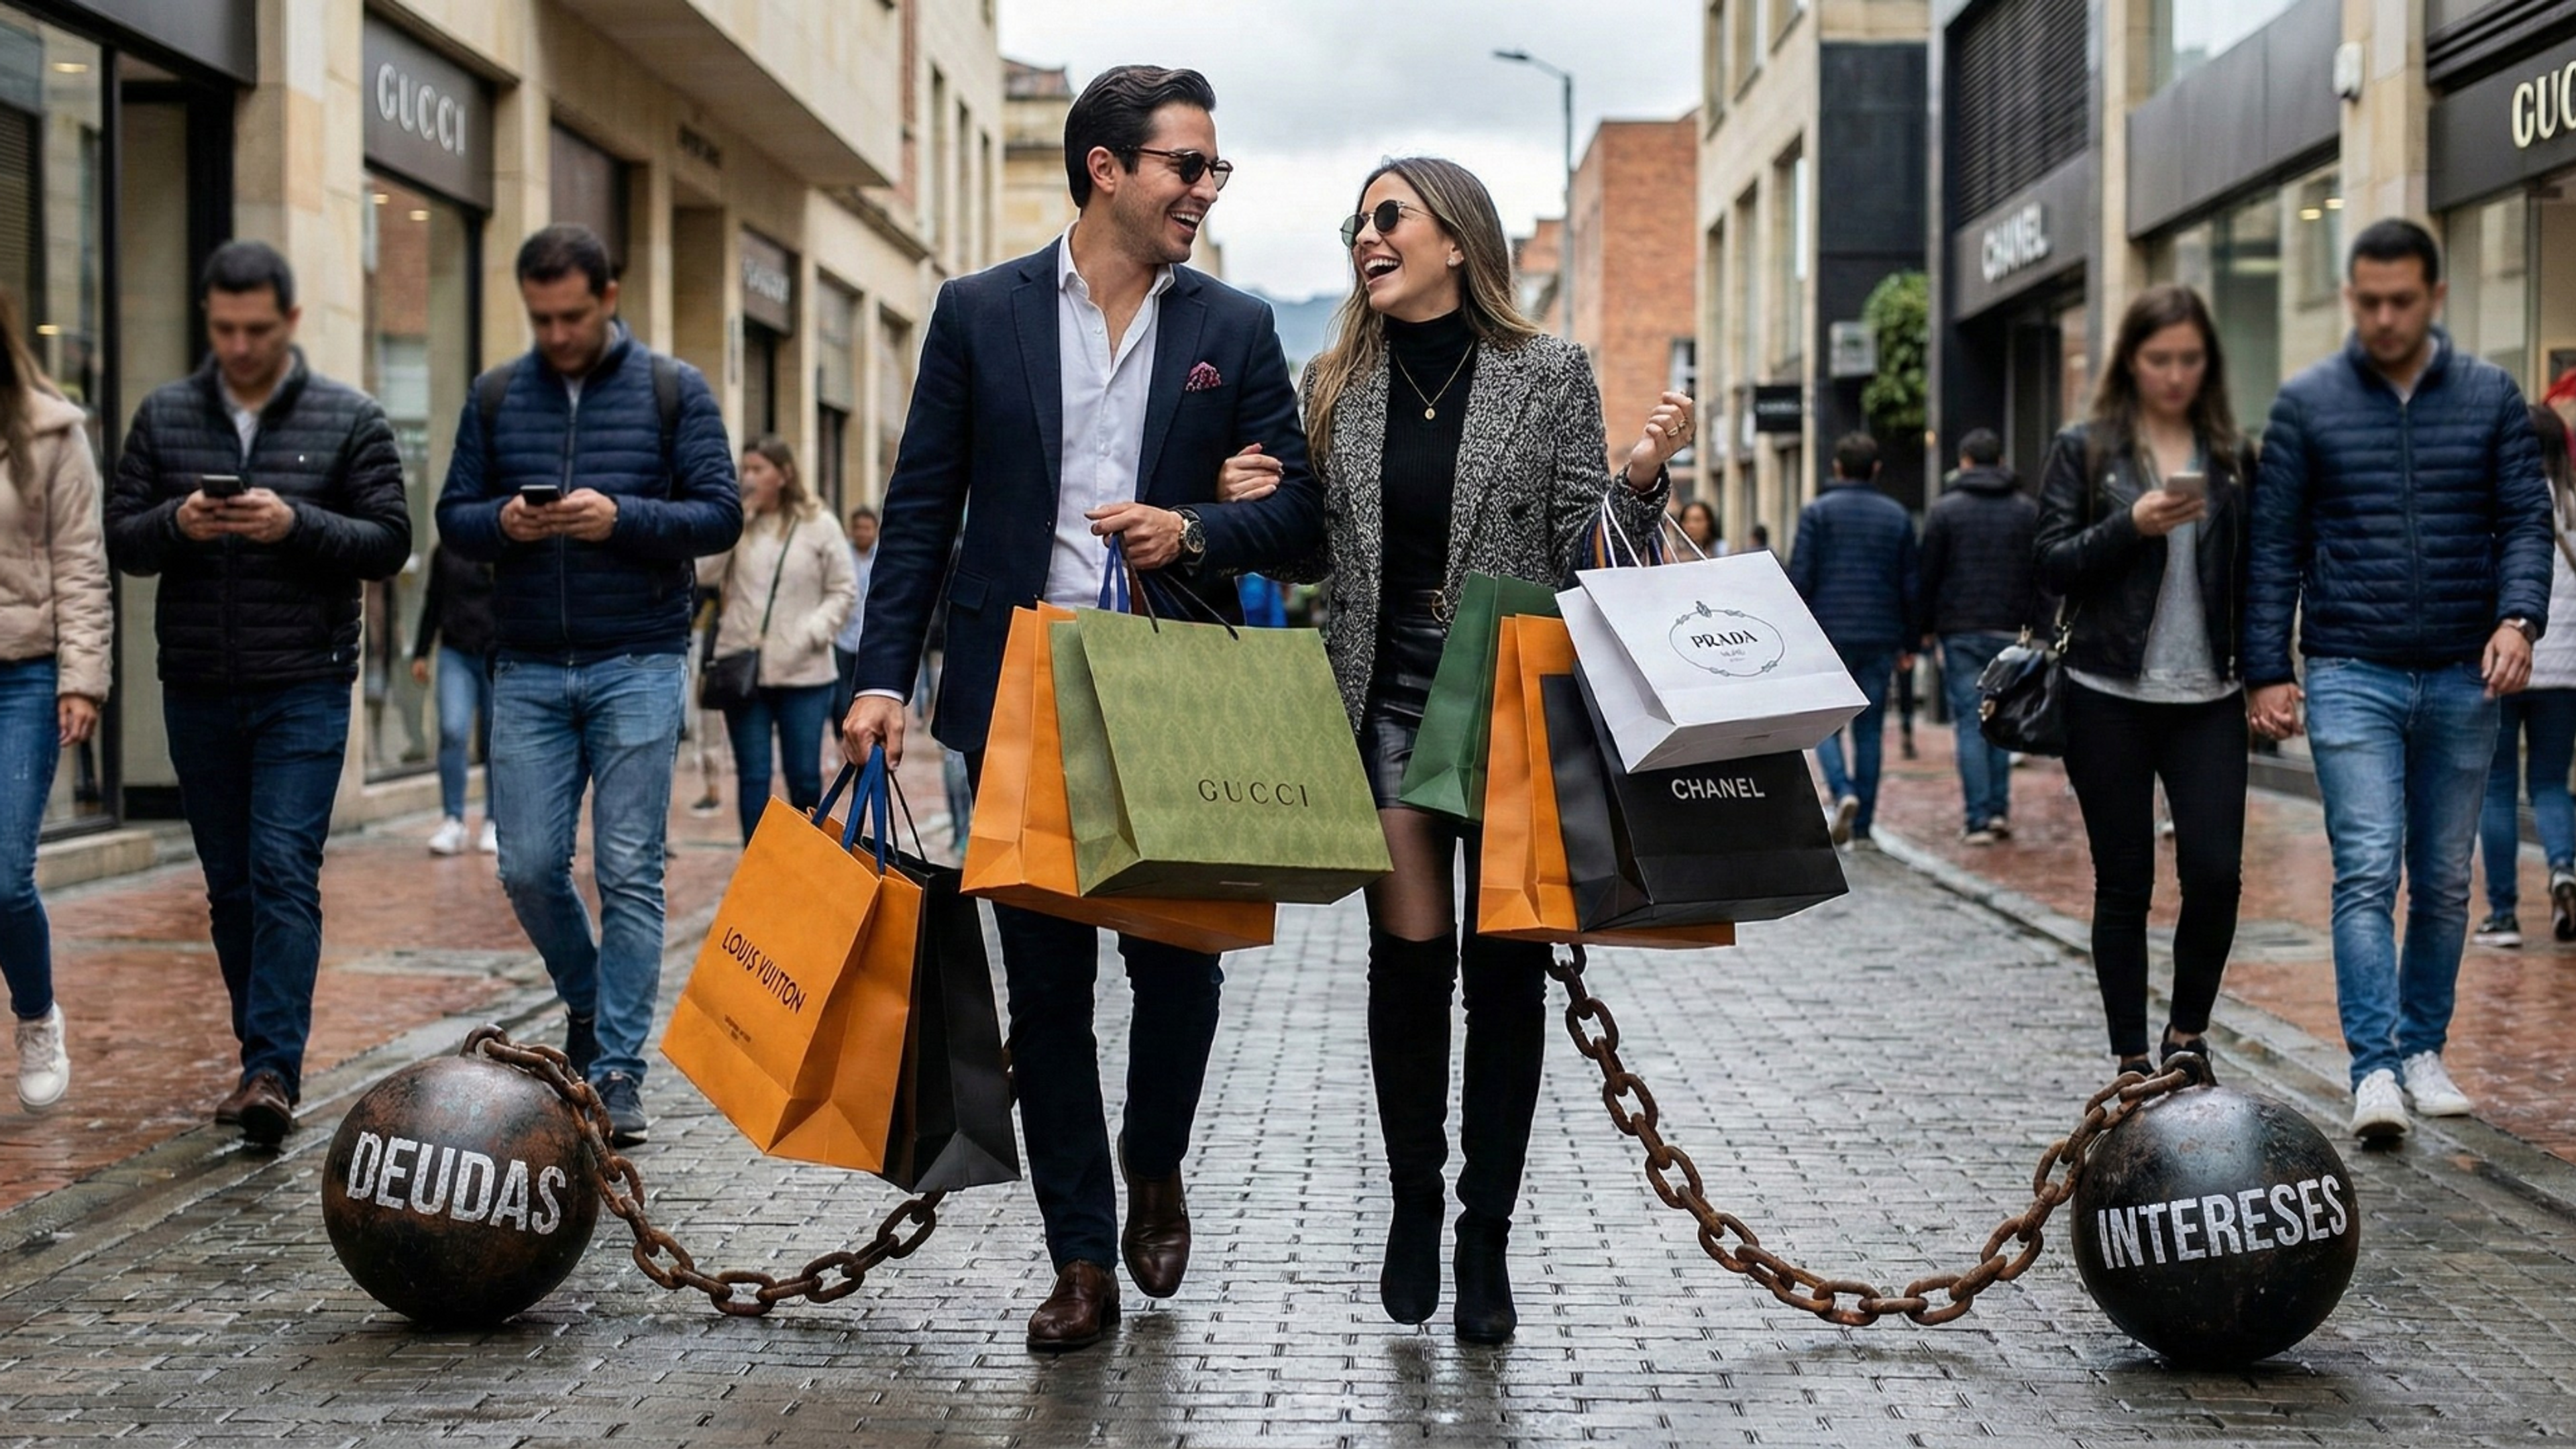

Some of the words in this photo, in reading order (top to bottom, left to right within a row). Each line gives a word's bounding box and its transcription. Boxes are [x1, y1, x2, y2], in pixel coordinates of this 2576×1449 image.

[377, 62, 466, 156] GUCCI
[1690, 630, 1758, 649] PRADA
[1198, 779, 1309, 807] GUCCI
[1671, 777, 1766, 800] CHANEL
[722, 926, 760, 971] LOUIS
[756, 955, 807, 1014] VUITTON
[346, 1131, 566, 1235] DEUDAS
[2098, 1175, 2347, 1269] INTERESES
